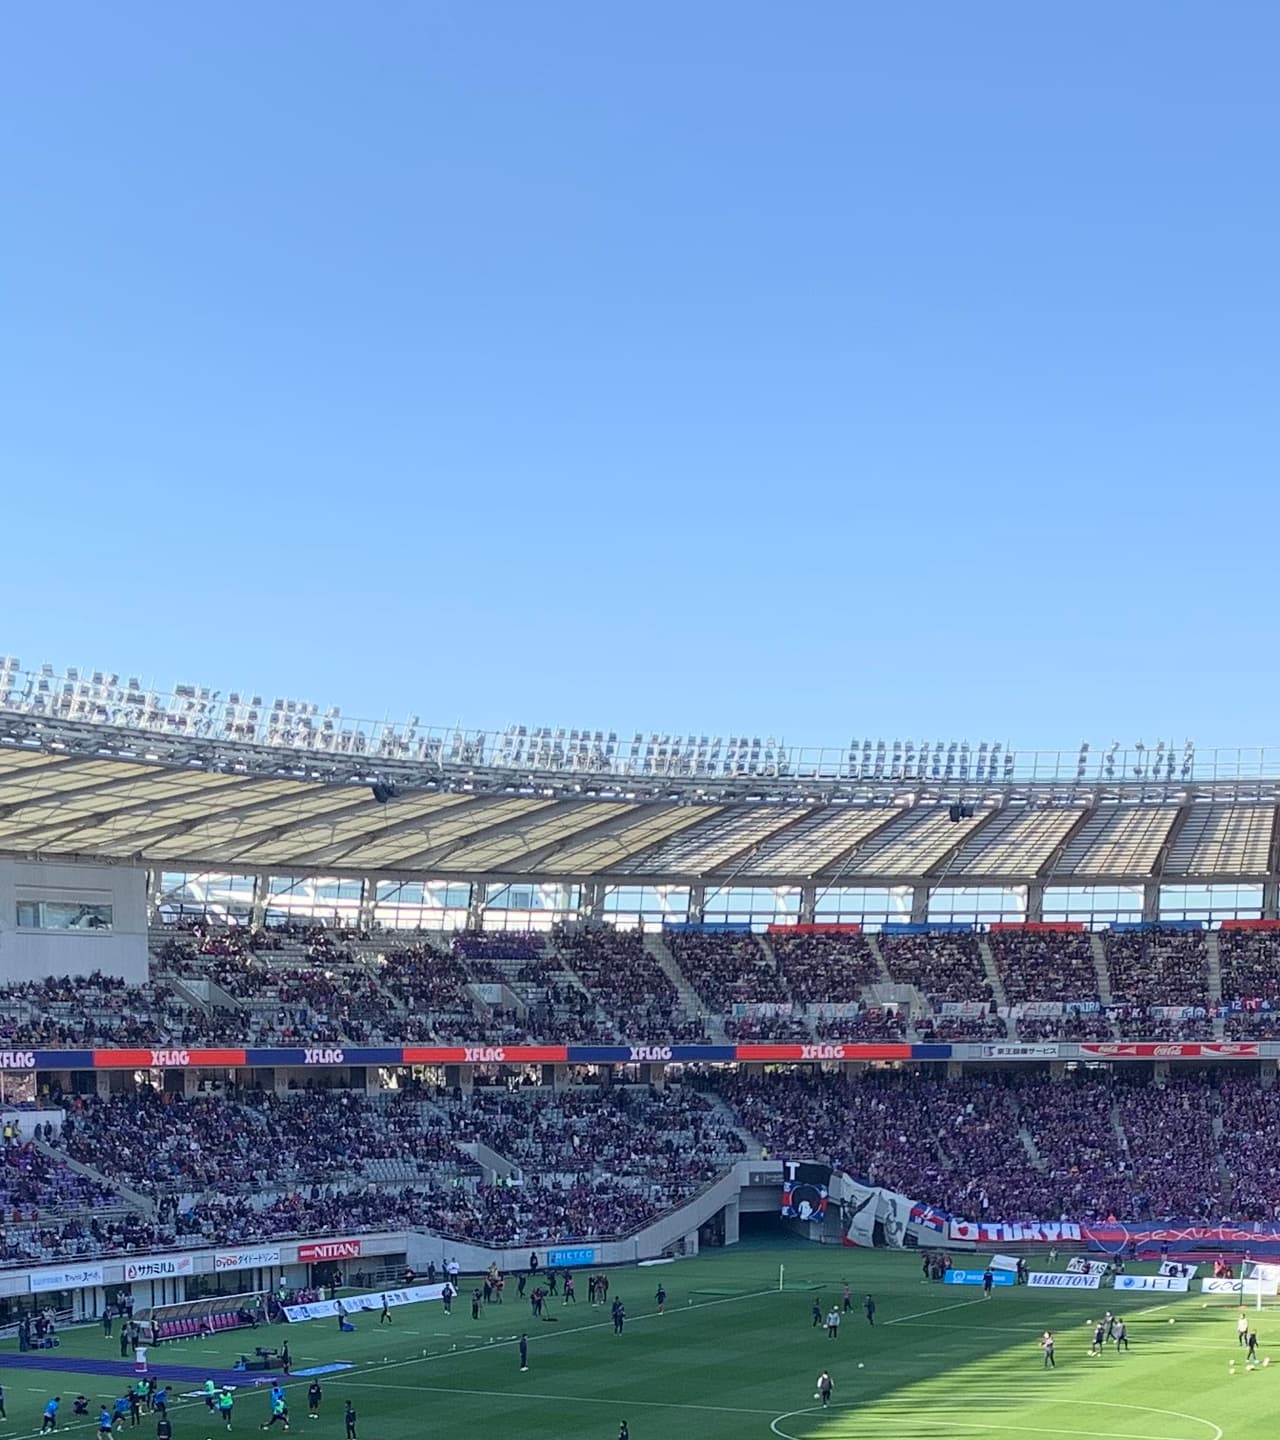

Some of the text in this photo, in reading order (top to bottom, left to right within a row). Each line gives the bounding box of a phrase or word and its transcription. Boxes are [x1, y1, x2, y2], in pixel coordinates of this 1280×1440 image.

[151, 1050, 190, 1066] XFLAG
[304, 1049, 344, 1064] XFLAG
[464, 1048, 505, 1062] XFLAG
[630, 1046, 672, 1061] XFLAG
[801, 1045, 845, 1059] XFLAG
[981, 1223, 1082, 1241] TOKYO
[314, 1243, 354, 1258] NITTAN
[1030, 1274, 1097, 1286] MARUTONE
